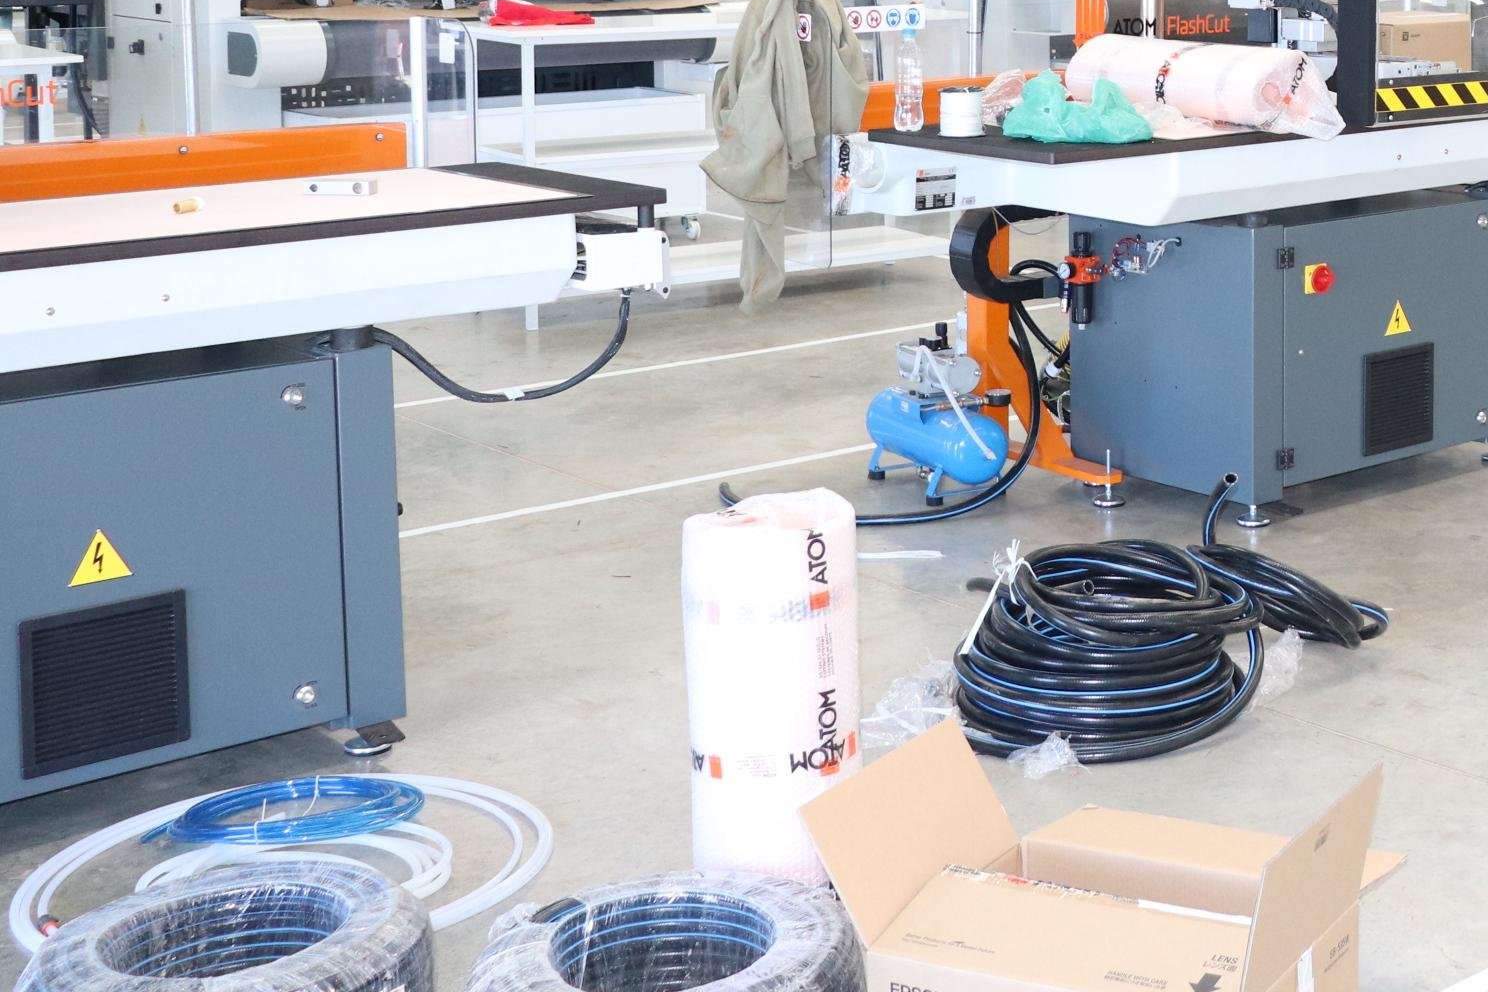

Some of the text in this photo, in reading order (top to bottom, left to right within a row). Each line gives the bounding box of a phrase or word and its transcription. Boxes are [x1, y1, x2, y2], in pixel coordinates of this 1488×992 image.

[1113, 14, 1231, 36] ATOM FlashCut
[1290, 56, 1308, 95] ATOM
[818, 688, 838, 753] ATOM
[1211, 954, 1239, 965] LENS
